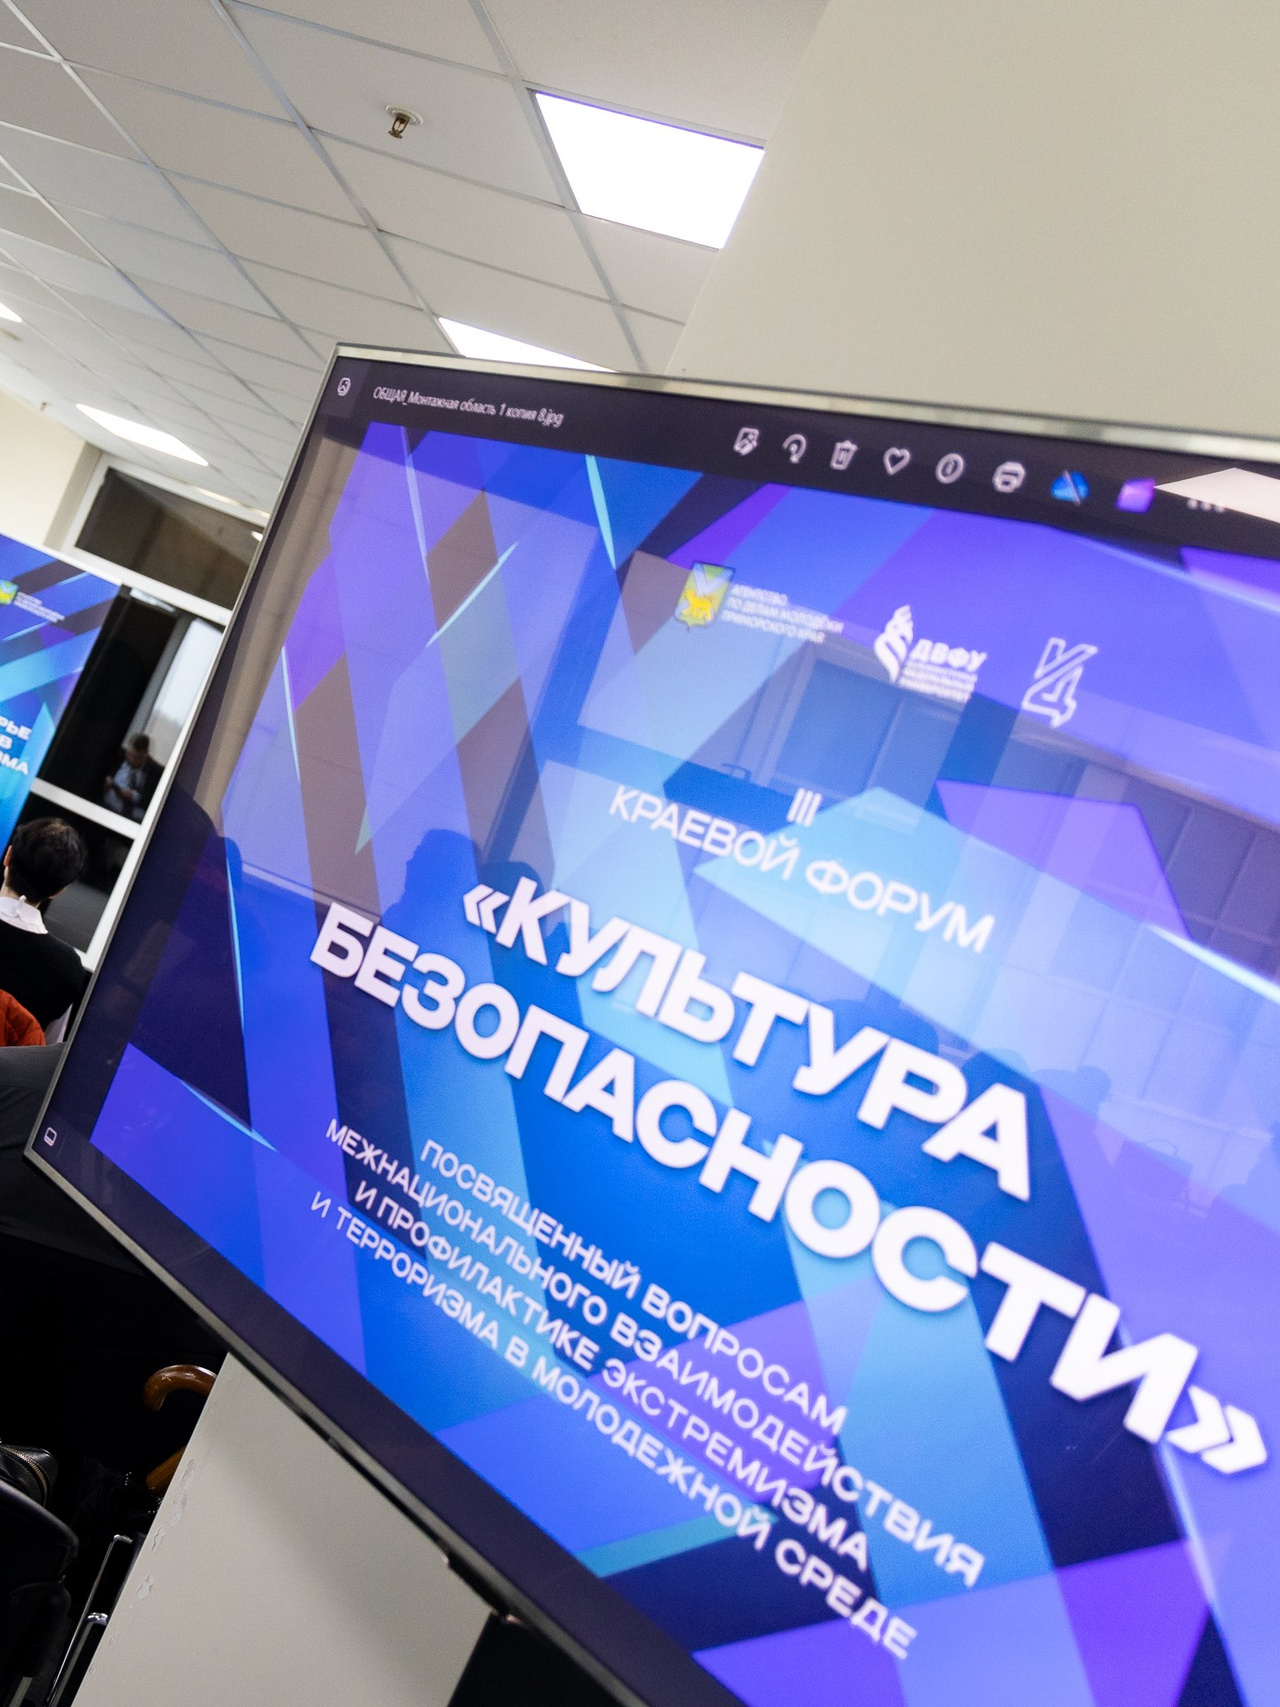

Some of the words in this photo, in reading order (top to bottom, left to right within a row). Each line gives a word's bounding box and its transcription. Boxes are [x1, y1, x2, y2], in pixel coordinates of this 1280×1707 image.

[499, 402, 507, 416] 1
[909, 638, 988, 673] ДВФУ
[608, 784, 802, 882] КРАЕВОЙ
[804, 858, 996, 955] ФОРУМ
[308, 900, 1269, 1475] БЕЗОПАСНОСТИ»
[461, 876, 1031, 1202] «КУЛЬТУРА
[310, 1190, 332, 1220] И
[335, 1205, 500, 1350] ТЕРРОРИЗМА
[503, 1335, 530, 1369] В
[530, 1355, 773, 1553] МОЛОДЕЖНОЙ
[773, 1537, 919, 1661] СРЕДЕ
[325, 1118, 608, 1326] МЕЖНАЦИОНАЛЬНОГО
[609, 1311, 986, 1589] ВЗАИМОДЕЙСТВИЯ
[354, 1180, 378, 1210] И
[377, 1196, 601, 1372] ПРОФИЛАКТИКЕ
[601, 1357, 869, 1573] ЭКСТРЕМИЗМА
[419, 1138, 642, 1300] ПОСВЯЩЕННЫЙ
[641, 1282, 849, 1437] ВОПРОСАМ
